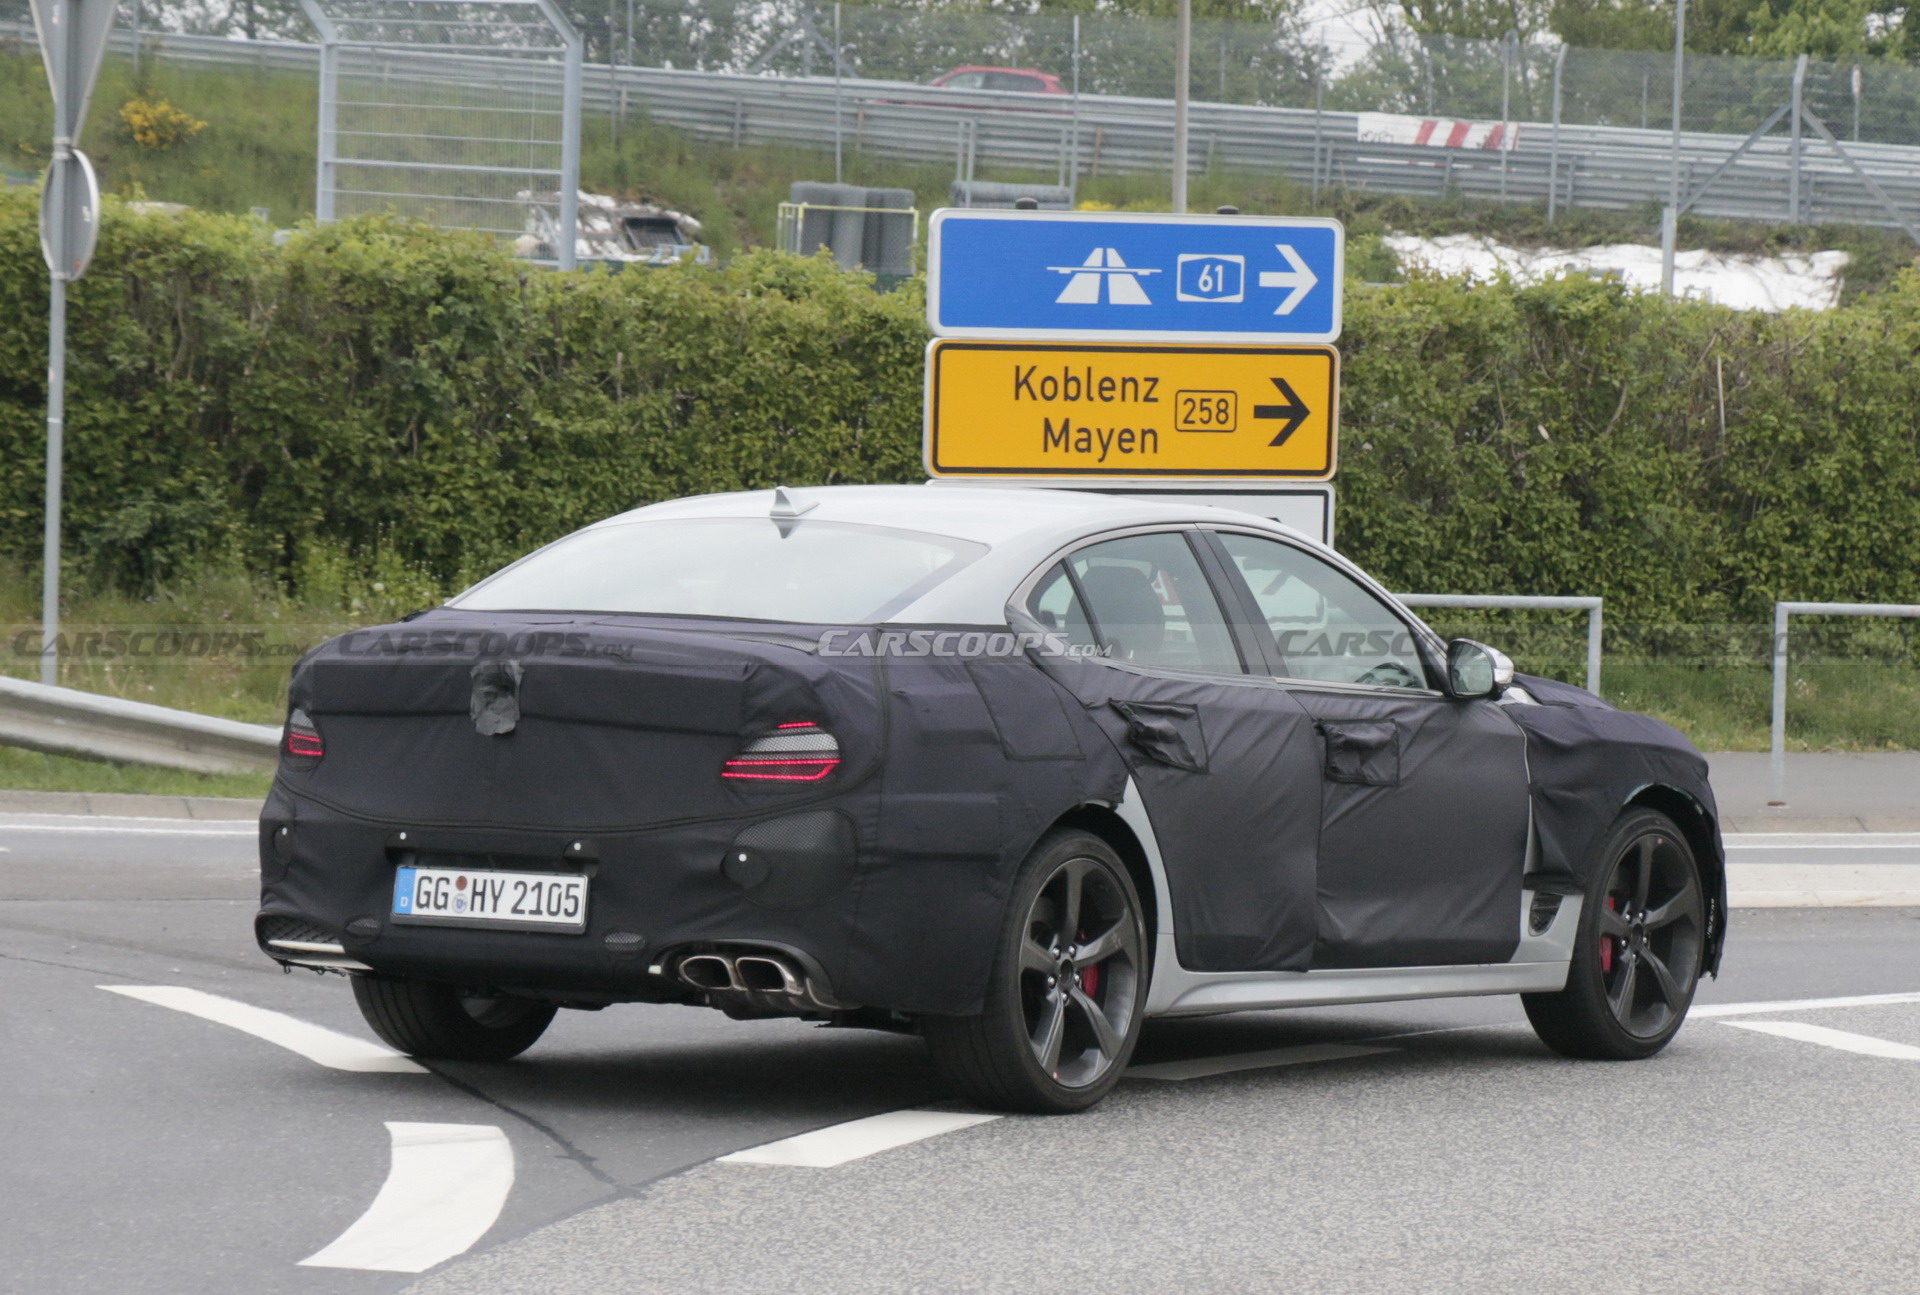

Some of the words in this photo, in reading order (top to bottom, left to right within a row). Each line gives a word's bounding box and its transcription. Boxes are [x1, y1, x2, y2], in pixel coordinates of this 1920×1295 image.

[1198, 264, 1224, 293] 61
[1014, 364, 1160, 403] Koblenz
[1182, 397, 1230, 425] 258
[1043, 416, 1159, 463] Mayen
[400, 896, 409, 907] D
[415, 875, 450, 910] GG
[470, 878, 505, 913] HY
[510, 880, 580, 918] 2105
